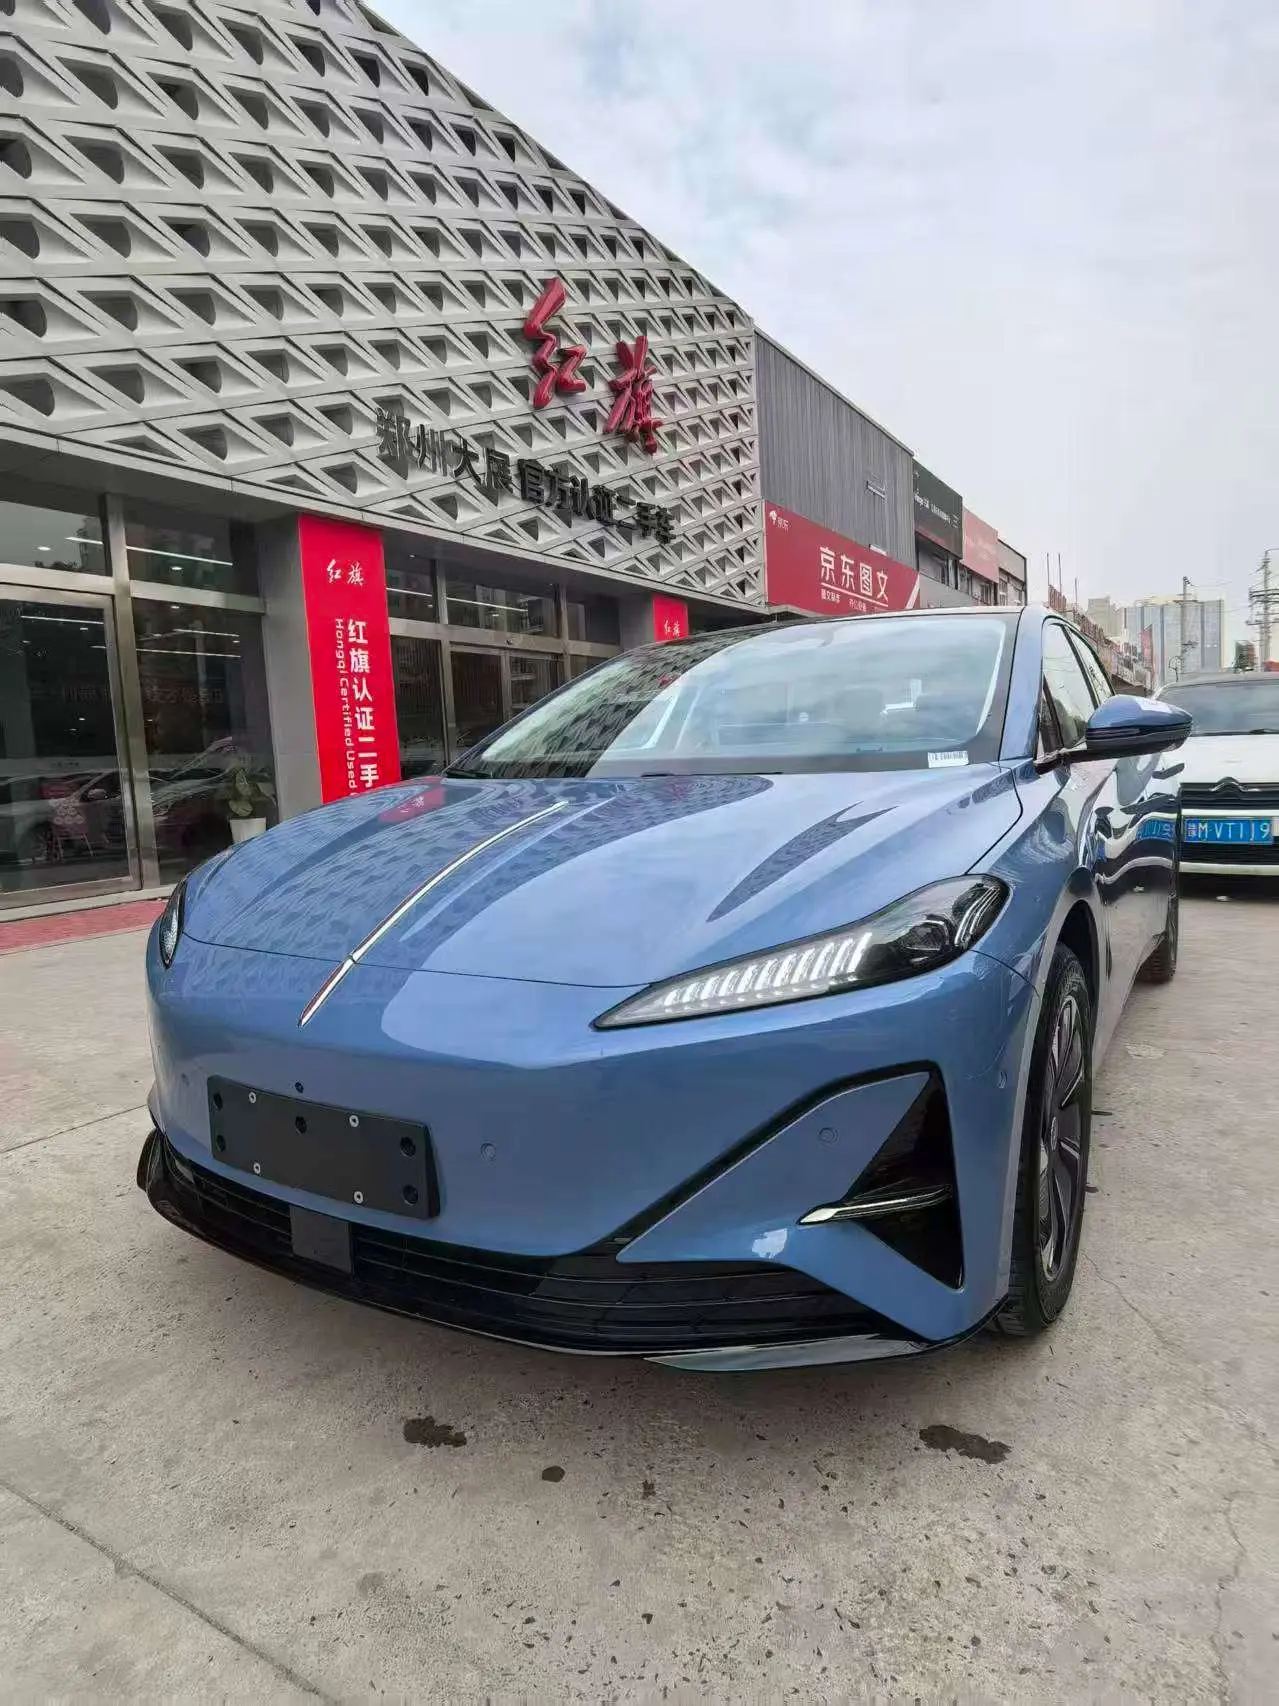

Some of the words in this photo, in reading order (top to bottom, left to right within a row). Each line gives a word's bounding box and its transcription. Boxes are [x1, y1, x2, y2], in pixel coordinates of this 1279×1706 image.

[522, 277, 663, 454] 红旗
[326, 559, 366, 587] 红旗
[819, 546, 888, 603] 京东图文
[335, 618, 348, 673] Hongqi
[664, 620, 680, 636] 红旗
[339, 677, 355, 747] Certified
[347, 619, 379, 788] 红旗认证二手
[345, 750, 358, 789] Used
